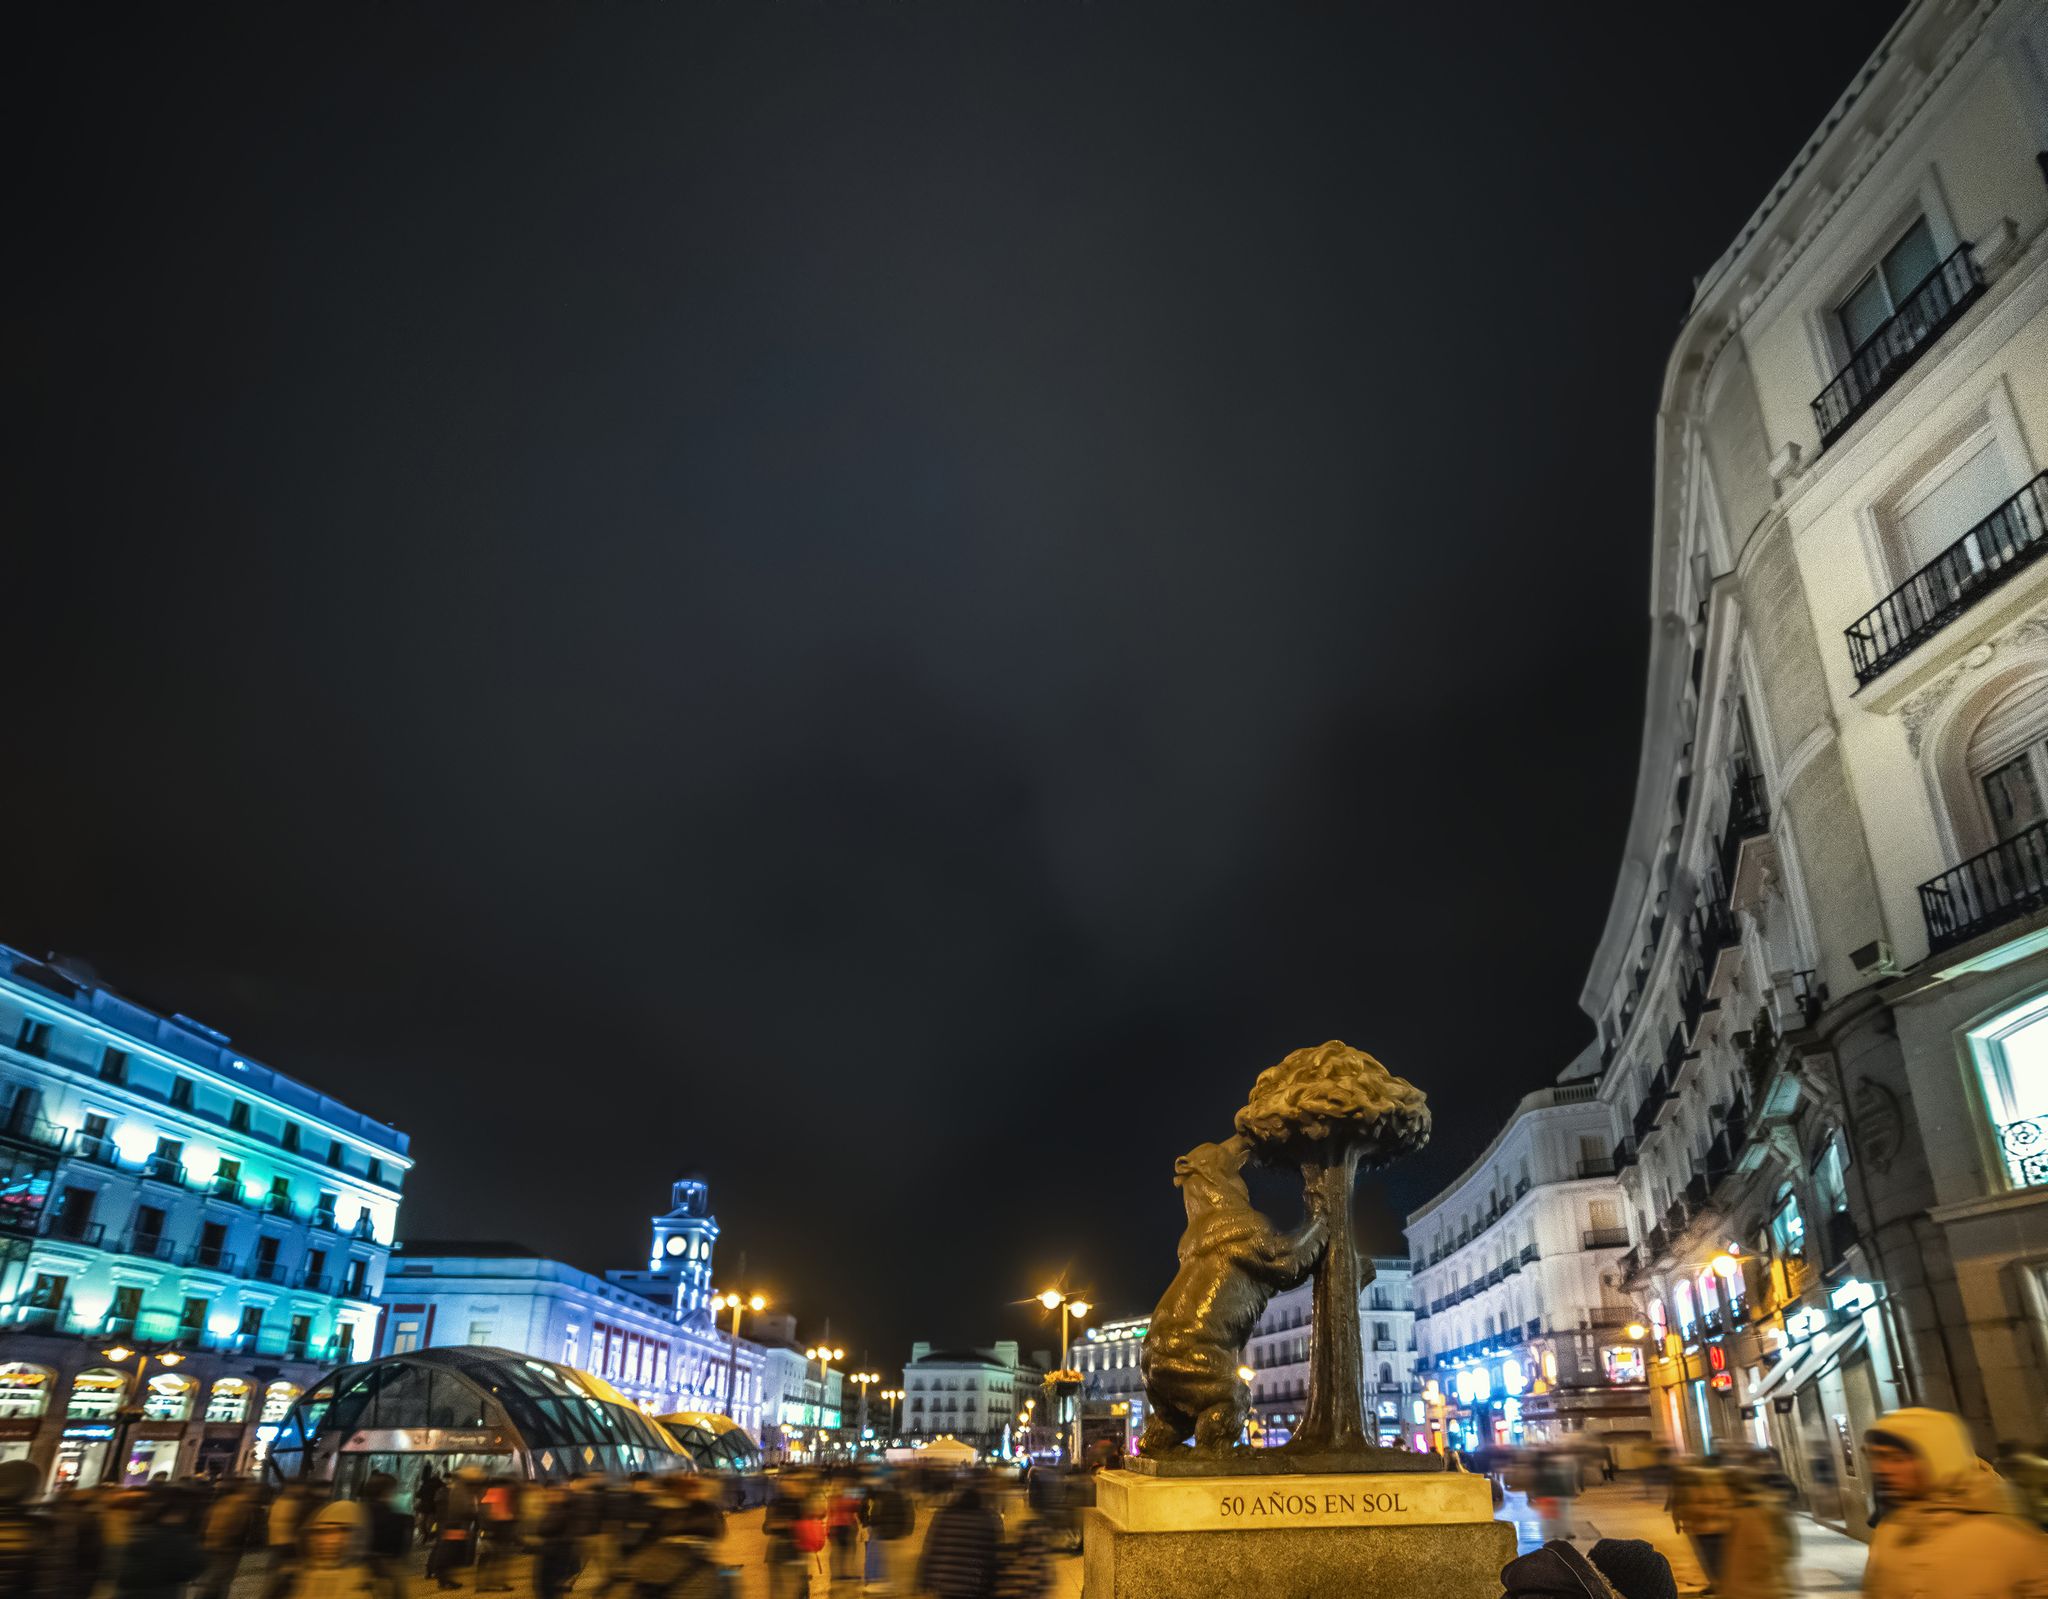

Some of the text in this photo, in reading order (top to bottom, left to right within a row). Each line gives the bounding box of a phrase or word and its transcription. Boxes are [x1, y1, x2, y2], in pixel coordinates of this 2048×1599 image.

[1221, 1491, 1408, 1516] 50 AÑOS EN SOL
